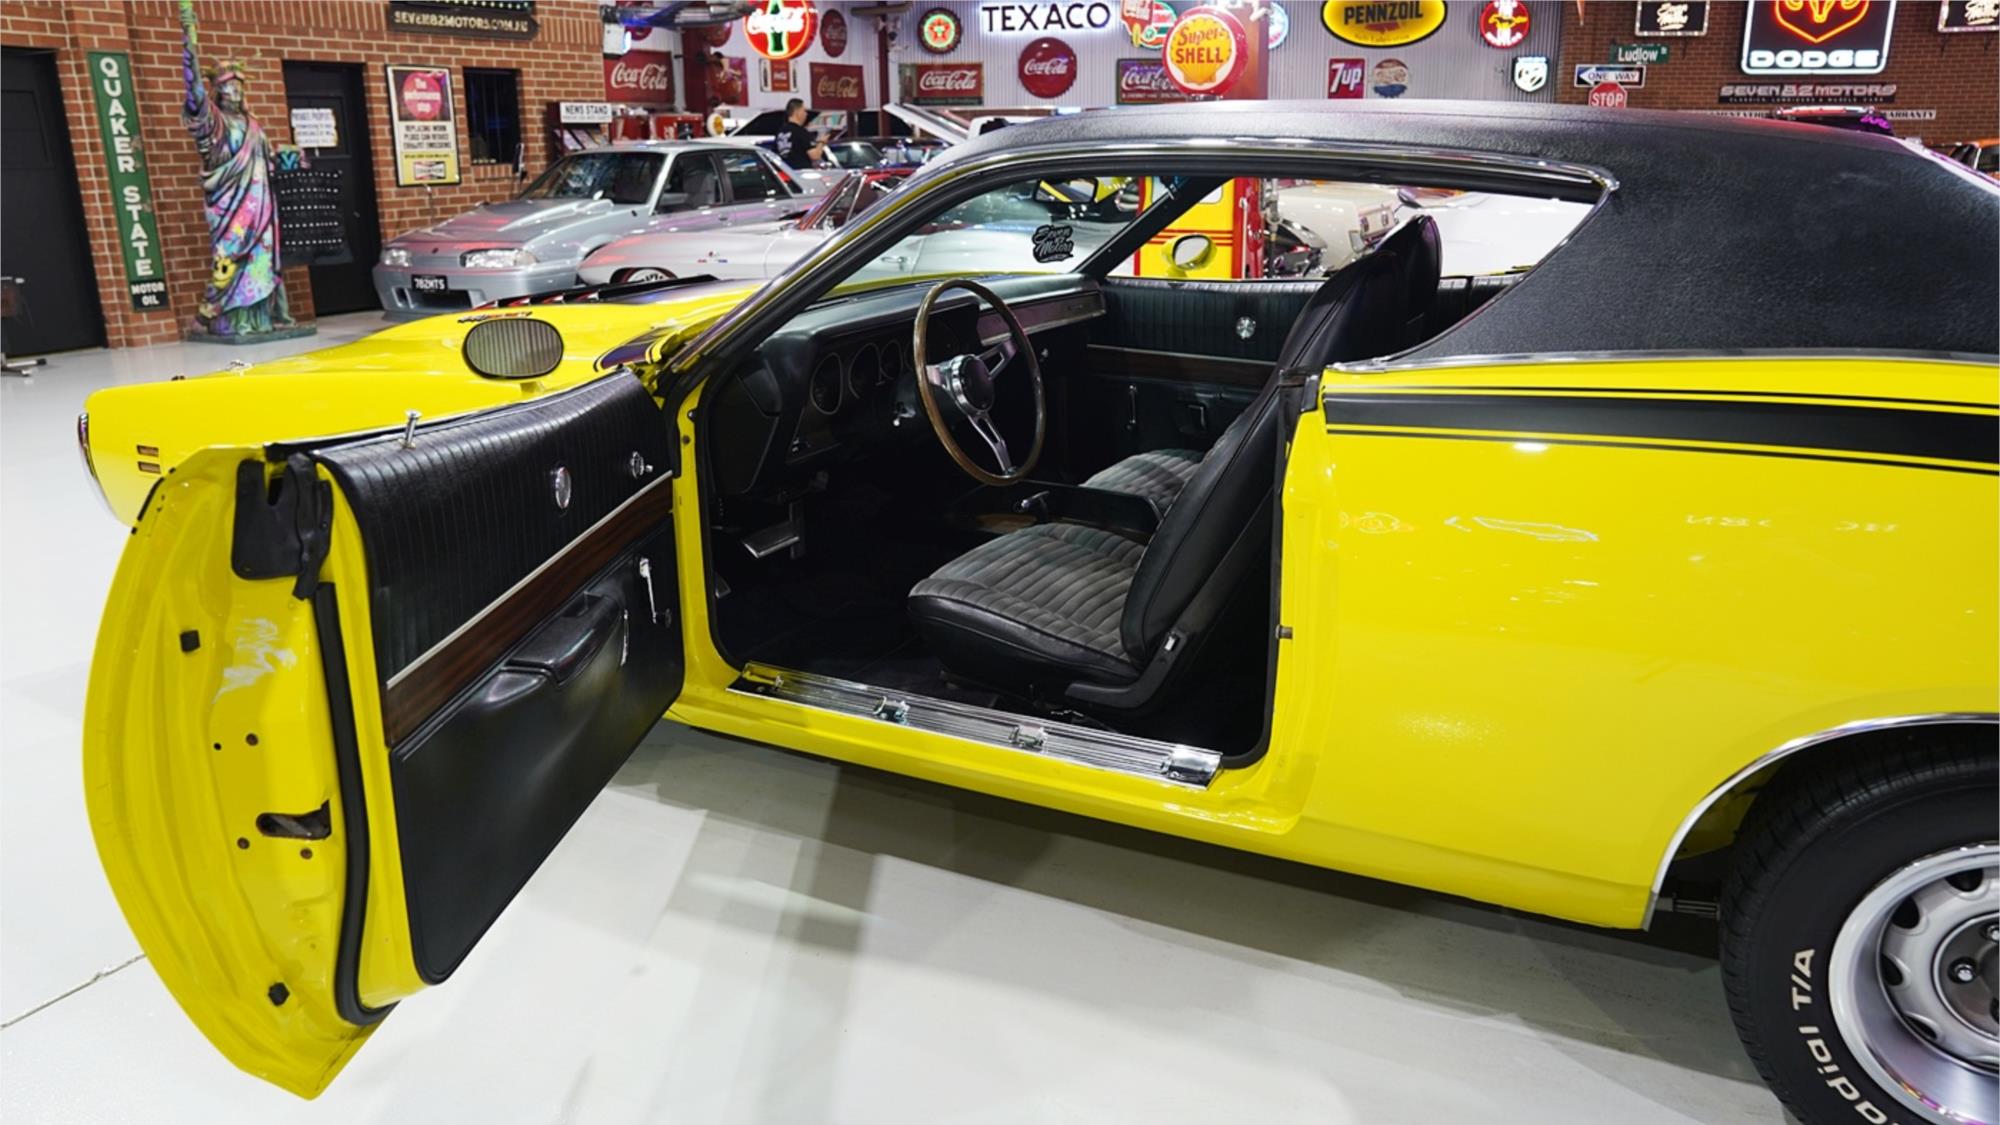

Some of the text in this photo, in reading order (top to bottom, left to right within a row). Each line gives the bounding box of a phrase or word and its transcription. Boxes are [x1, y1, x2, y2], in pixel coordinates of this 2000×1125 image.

[982, 3, 1111, 31] TEXACO
[1344, 1, 1423, 25] PENNZOIL
[1176, 48, 1224, 64] SHELL
[1618, 47, 1658, 62] Ludlow
[1750, 49, 1880, 68] DODGE
[611, 62, 668, 90] Coca-Cola
[920, 70, 977, 91] Coca-Cola
[1329, 62, 1362, 93] 7up
[1588, 71, 1637, 80] ONE WAY
[1591, 92, 1624, 107] STOP
[1721, 85, 1780, 96] SEVEN
[1815, 84, 1897, 96] MOTORS
[565, 105, 609, 115] NEWS STAND
[100, 57, 153, 277] QUAKER STATE
[131, 281, 165, 296] MOTOR
[142, 295, 160, 306] OIL
[1790, 949, 1815, 1011] T/A
[1798, 1025, 1900, 1125] adial
